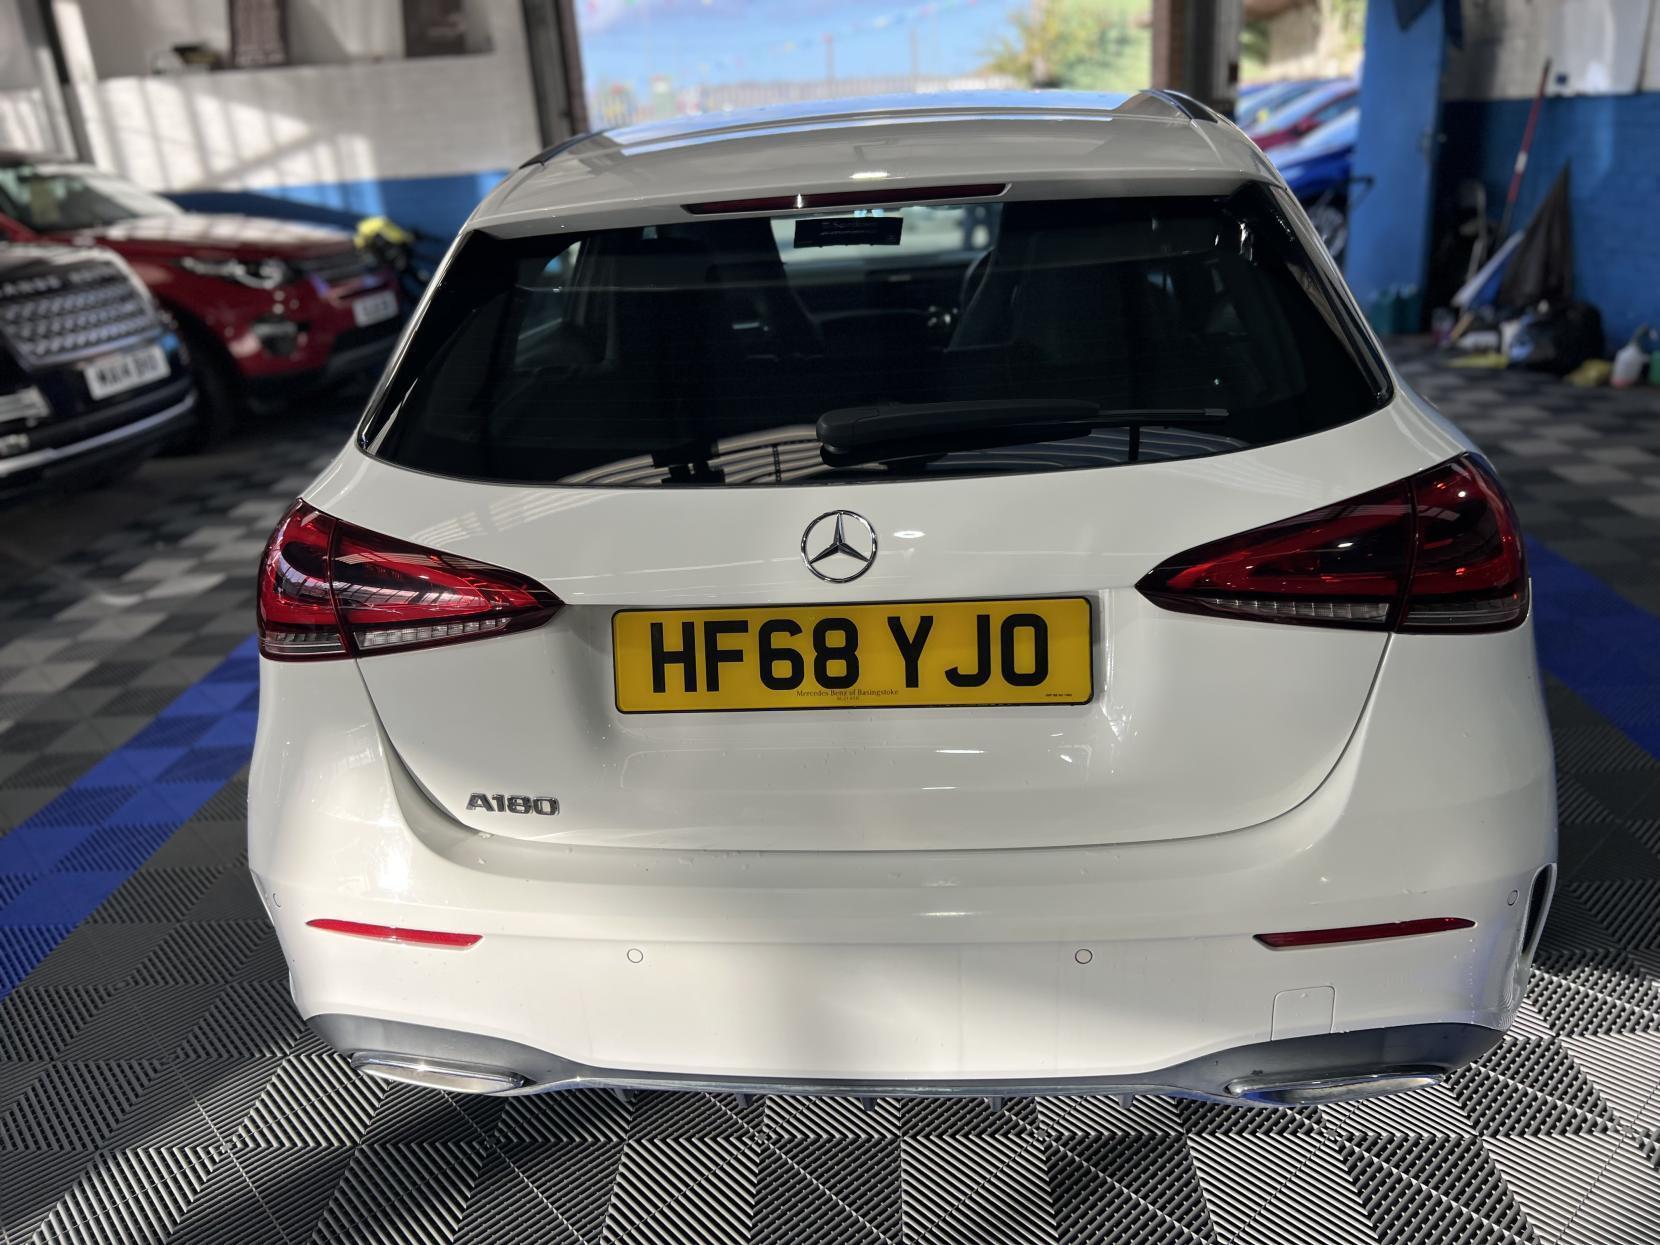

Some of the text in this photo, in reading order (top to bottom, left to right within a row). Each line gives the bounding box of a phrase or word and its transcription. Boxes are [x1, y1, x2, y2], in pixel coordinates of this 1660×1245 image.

[650, 613, 1049, 693] HF68 YJO
[796, 688, 899, 697] Mercedes Benz of Basingstoke
[465, 792, 560, 816] A180
